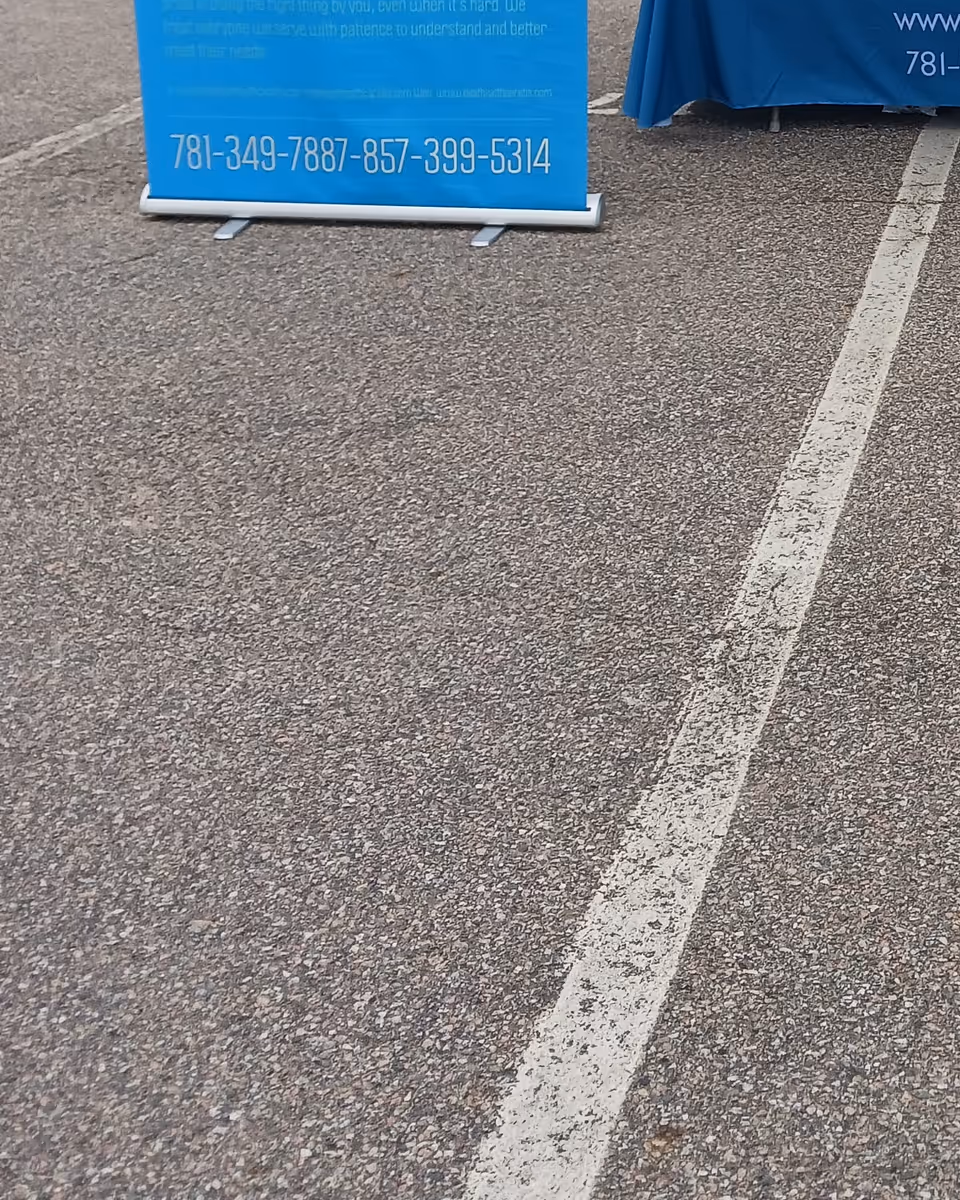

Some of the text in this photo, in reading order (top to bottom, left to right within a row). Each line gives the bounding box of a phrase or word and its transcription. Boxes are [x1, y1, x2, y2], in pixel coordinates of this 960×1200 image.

[378, 0, 407, 13] even
[396, 23, 408, 37] to
[410, 21, 481, 37] understand
[484, 20, 507, 36] and
[510, 20, 547, 37] better
[169, 132, 552, 175] 781-349-7887-857-399-5314
